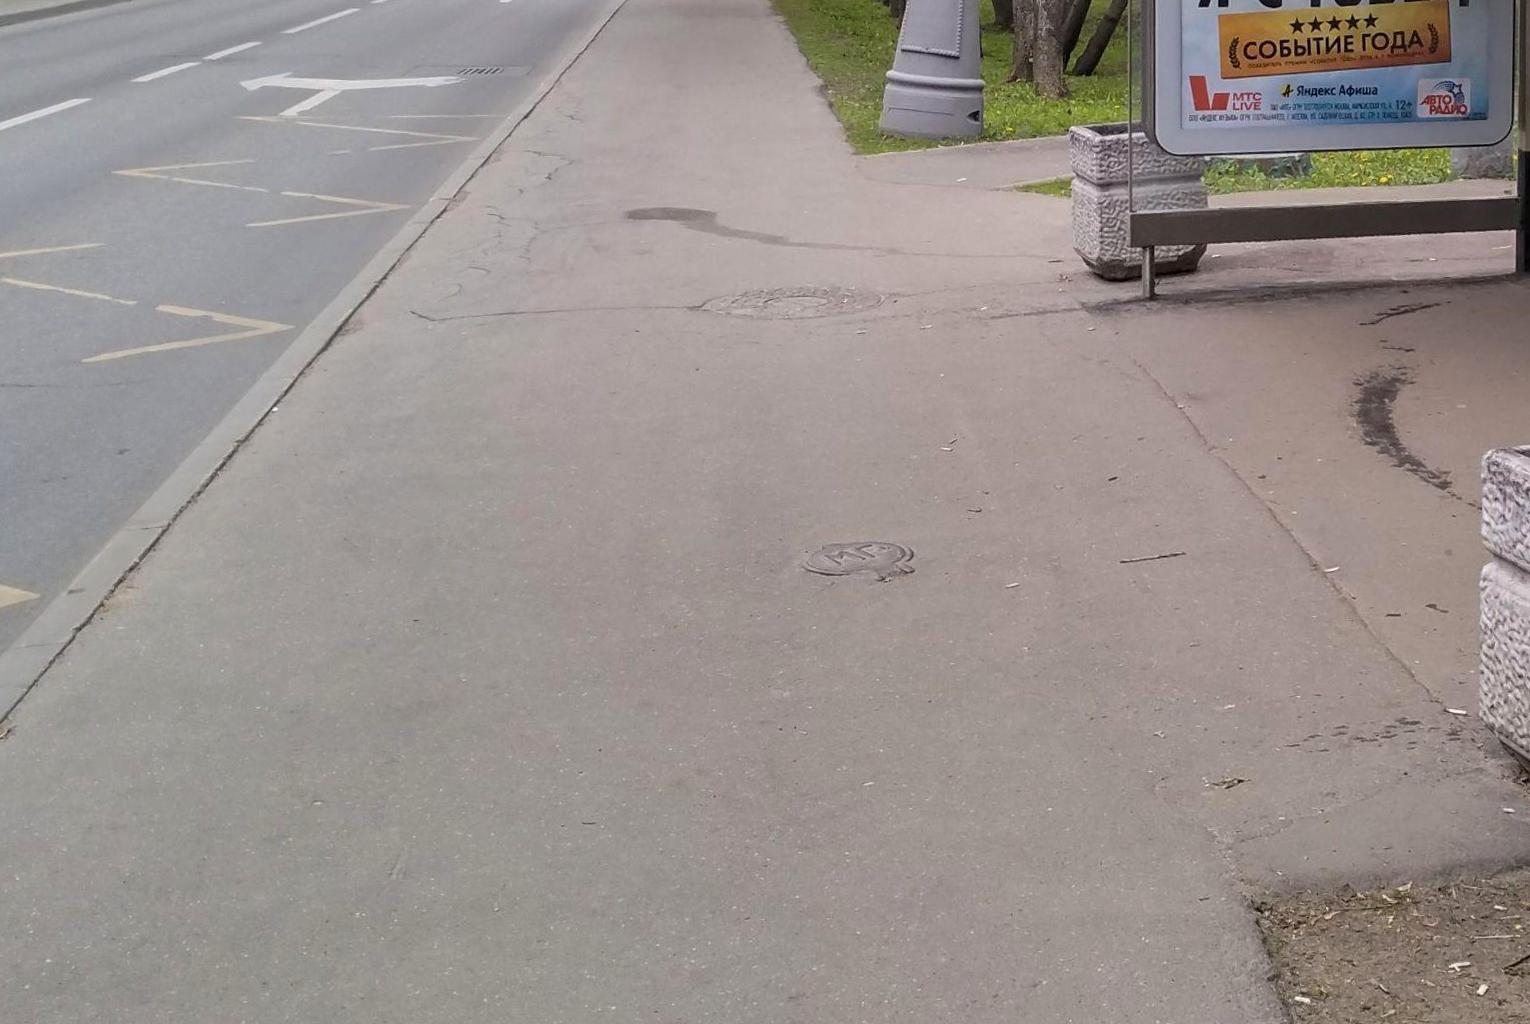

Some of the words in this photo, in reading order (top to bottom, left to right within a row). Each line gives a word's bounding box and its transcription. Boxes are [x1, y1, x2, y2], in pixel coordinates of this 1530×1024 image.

[1243, 34, 1354, 61] СОБЫТИЕ
[1361, 29, 1424, 54] ГОДА
[1296, 85, 1336, 97] Яндекс
[1338, 84, 1378, 97] Афиша
[1232, 92, 1262, 102] МТС
[1419, 94, 1452, 106] АВТО
[1232, 102, 1262, 111] LIVE
[1395, 99, 1413, 111] 12+
[1429, 103, 1468, 116] РАДИО
